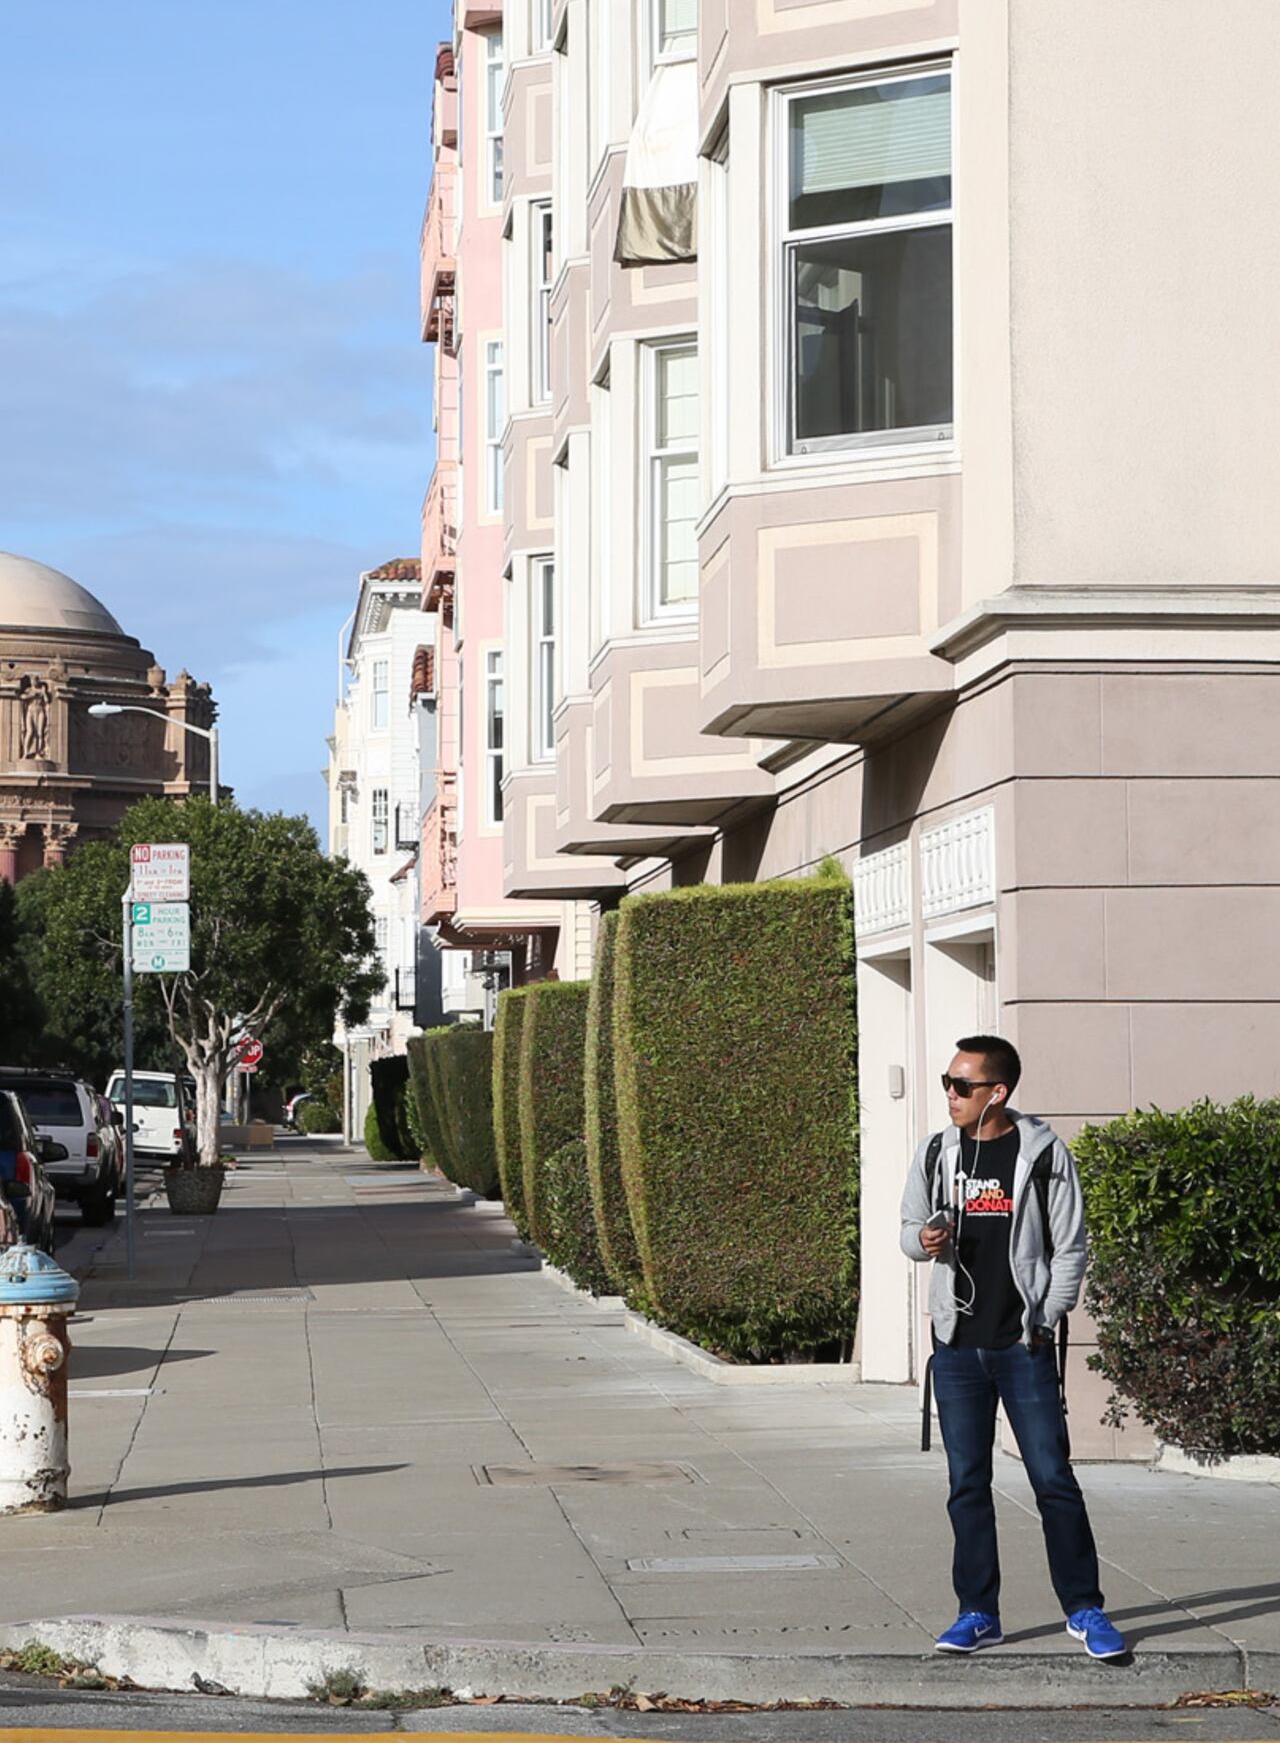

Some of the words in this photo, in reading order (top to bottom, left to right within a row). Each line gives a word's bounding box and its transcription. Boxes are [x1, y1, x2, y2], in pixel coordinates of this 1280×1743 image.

[134, 847, 149, 861] NO
[152, 849, 185, 860] PARKING
[135, 906, 149, 922] 2
[152, 916, 186, 924] PARKING
[966, 1179, 1000, 1189] STAND
[966, 1189, 980, 1200] UP
[980, 1188, 1004, 1200] AND
